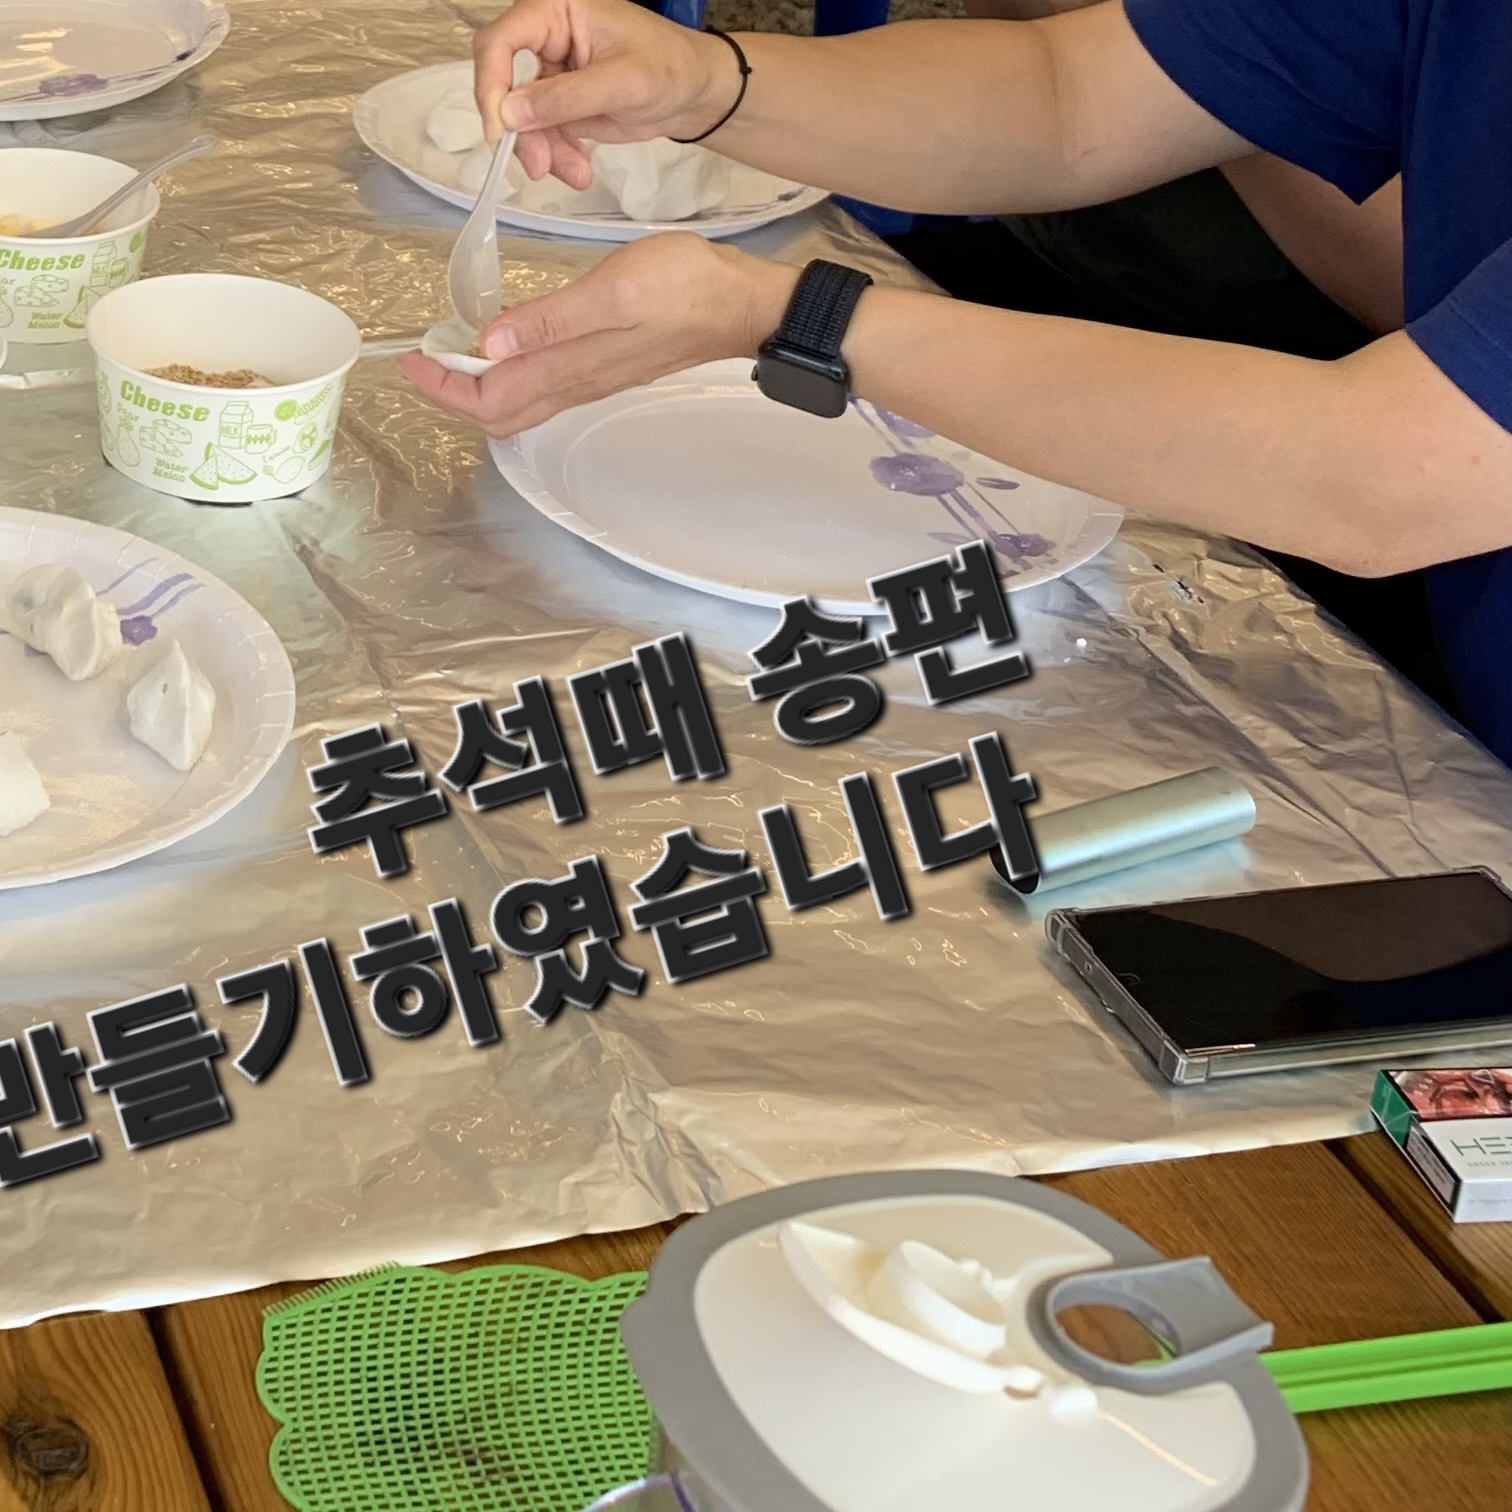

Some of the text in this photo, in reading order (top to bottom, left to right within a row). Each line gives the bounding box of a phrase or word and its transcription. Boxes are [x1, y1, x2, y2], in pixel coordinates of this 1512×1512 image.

[119, 379, 210, 422] Cheese
[220, 424, 240, 436] MILK
[155, 457, 189, 473] Water
[152, 466, 186, 483] Melon
[1449, 1136, 1512, 1157] HE
